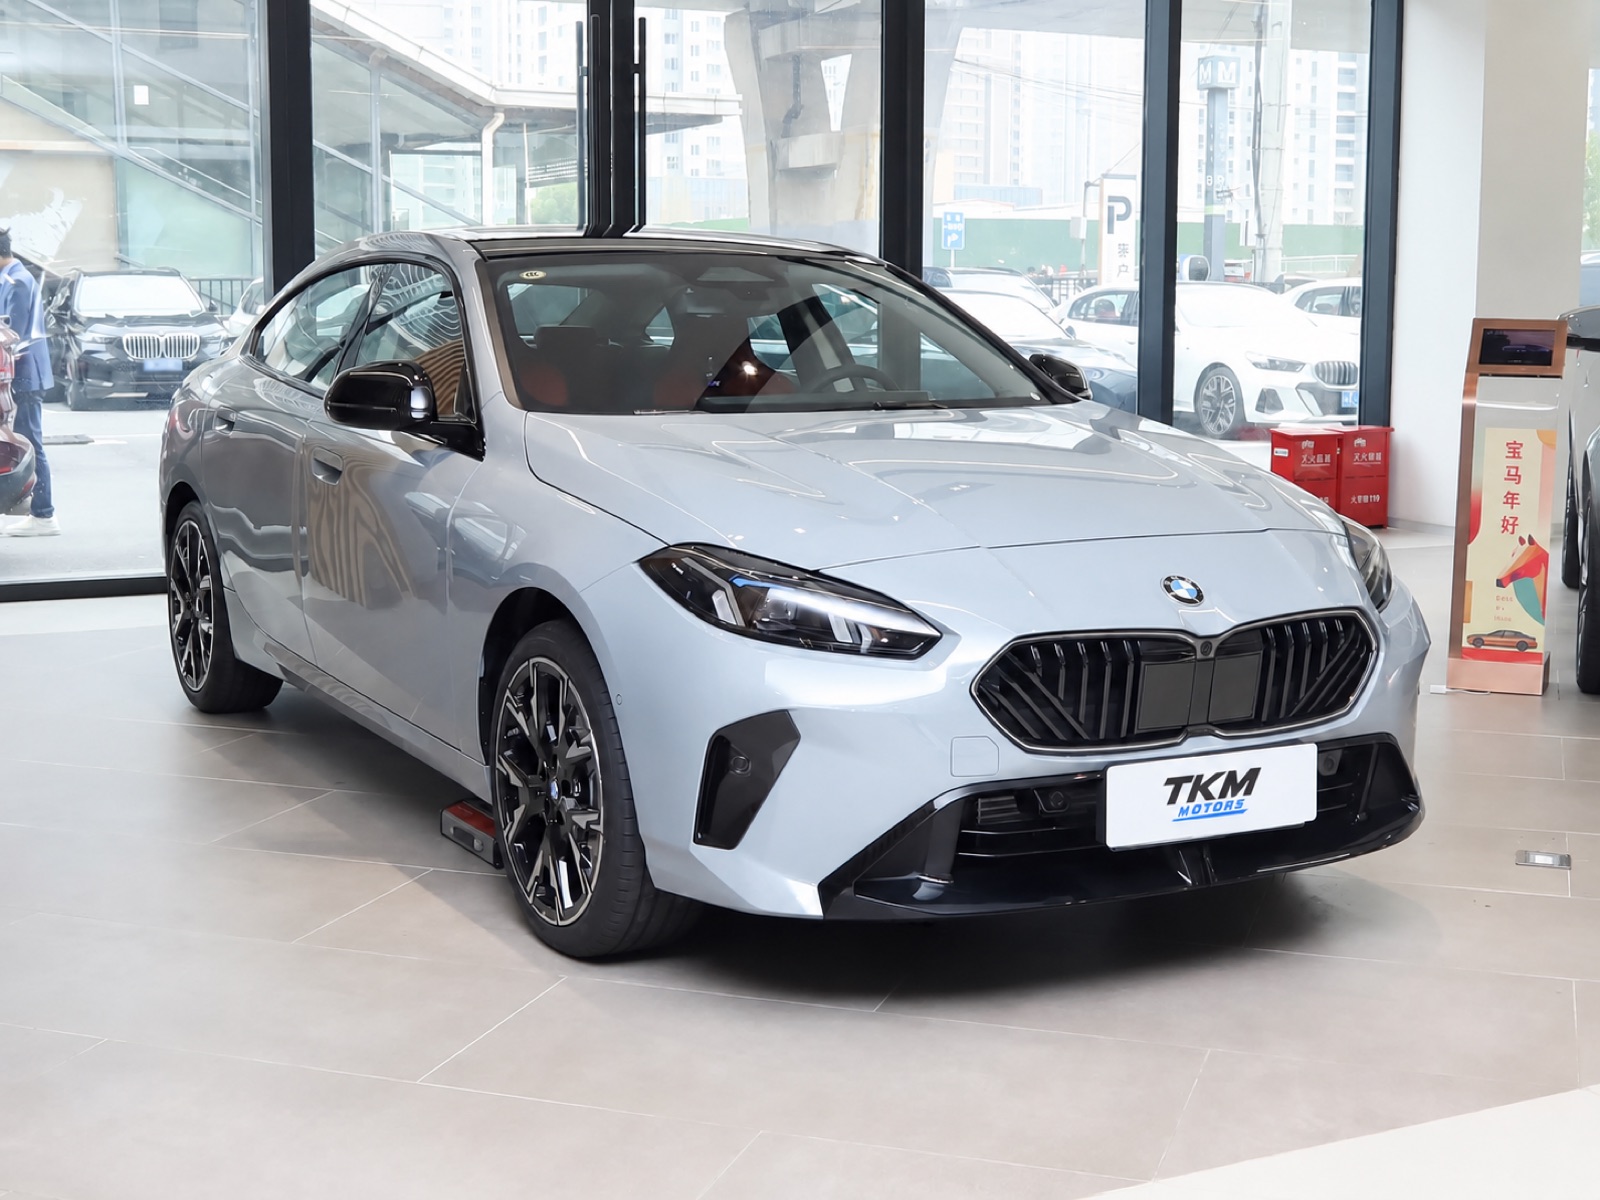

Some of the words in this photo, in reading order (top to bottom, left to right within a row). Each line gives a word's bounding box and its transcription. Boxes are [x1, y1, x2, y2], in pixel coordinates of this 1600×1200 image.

[1218, 60, 1237, 84] M
[1107, 195, 1132, 235] P
[1501, 440, 1523, 535] 宝马年好
[1163, 767, 1262, 806] TKM
[1178, 799, 1246, 818] MOTORS
